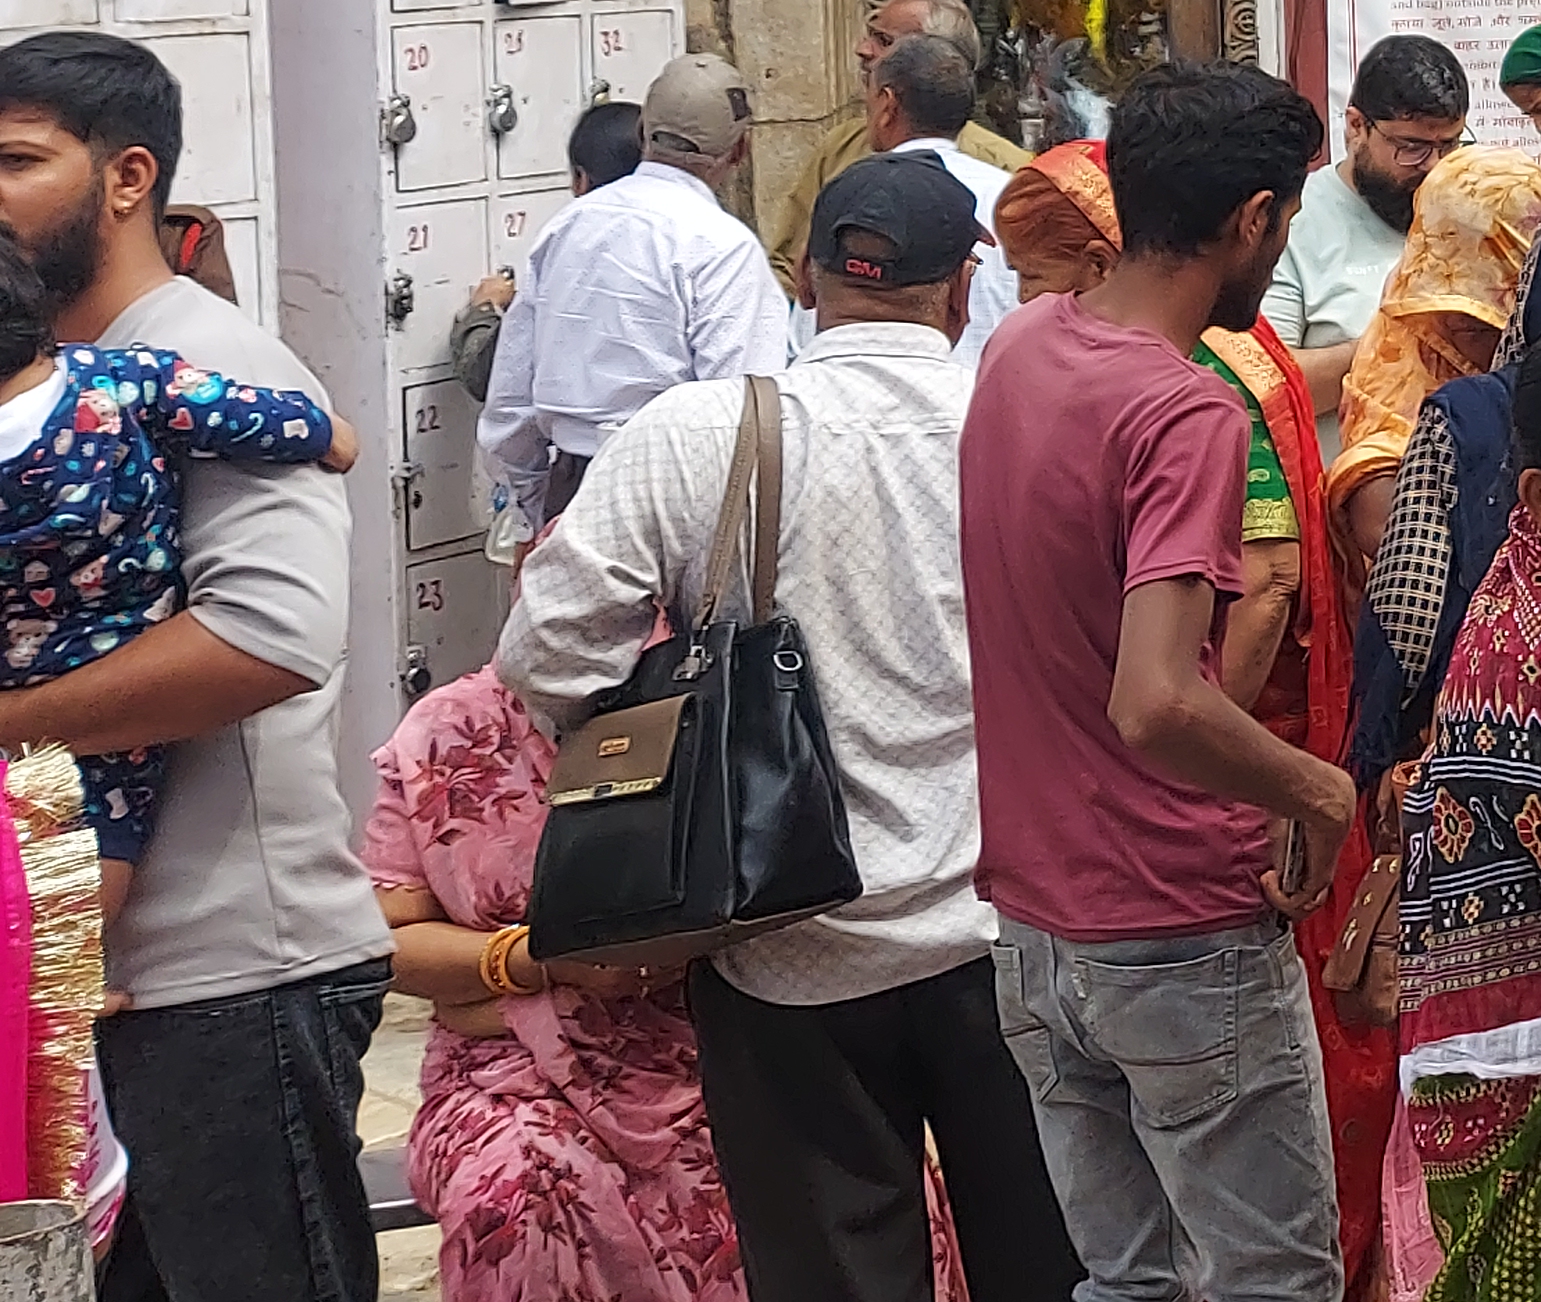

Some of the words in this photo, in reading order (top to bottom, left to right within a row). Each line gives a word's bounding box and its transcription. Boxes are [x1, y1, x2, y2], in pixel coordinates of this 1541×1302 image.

[404, 44, 429, 70] 20
[408, 225, 429, 251] 21
[415, 405, 441, 433] 22
[417, 579, 443, 611] 23
